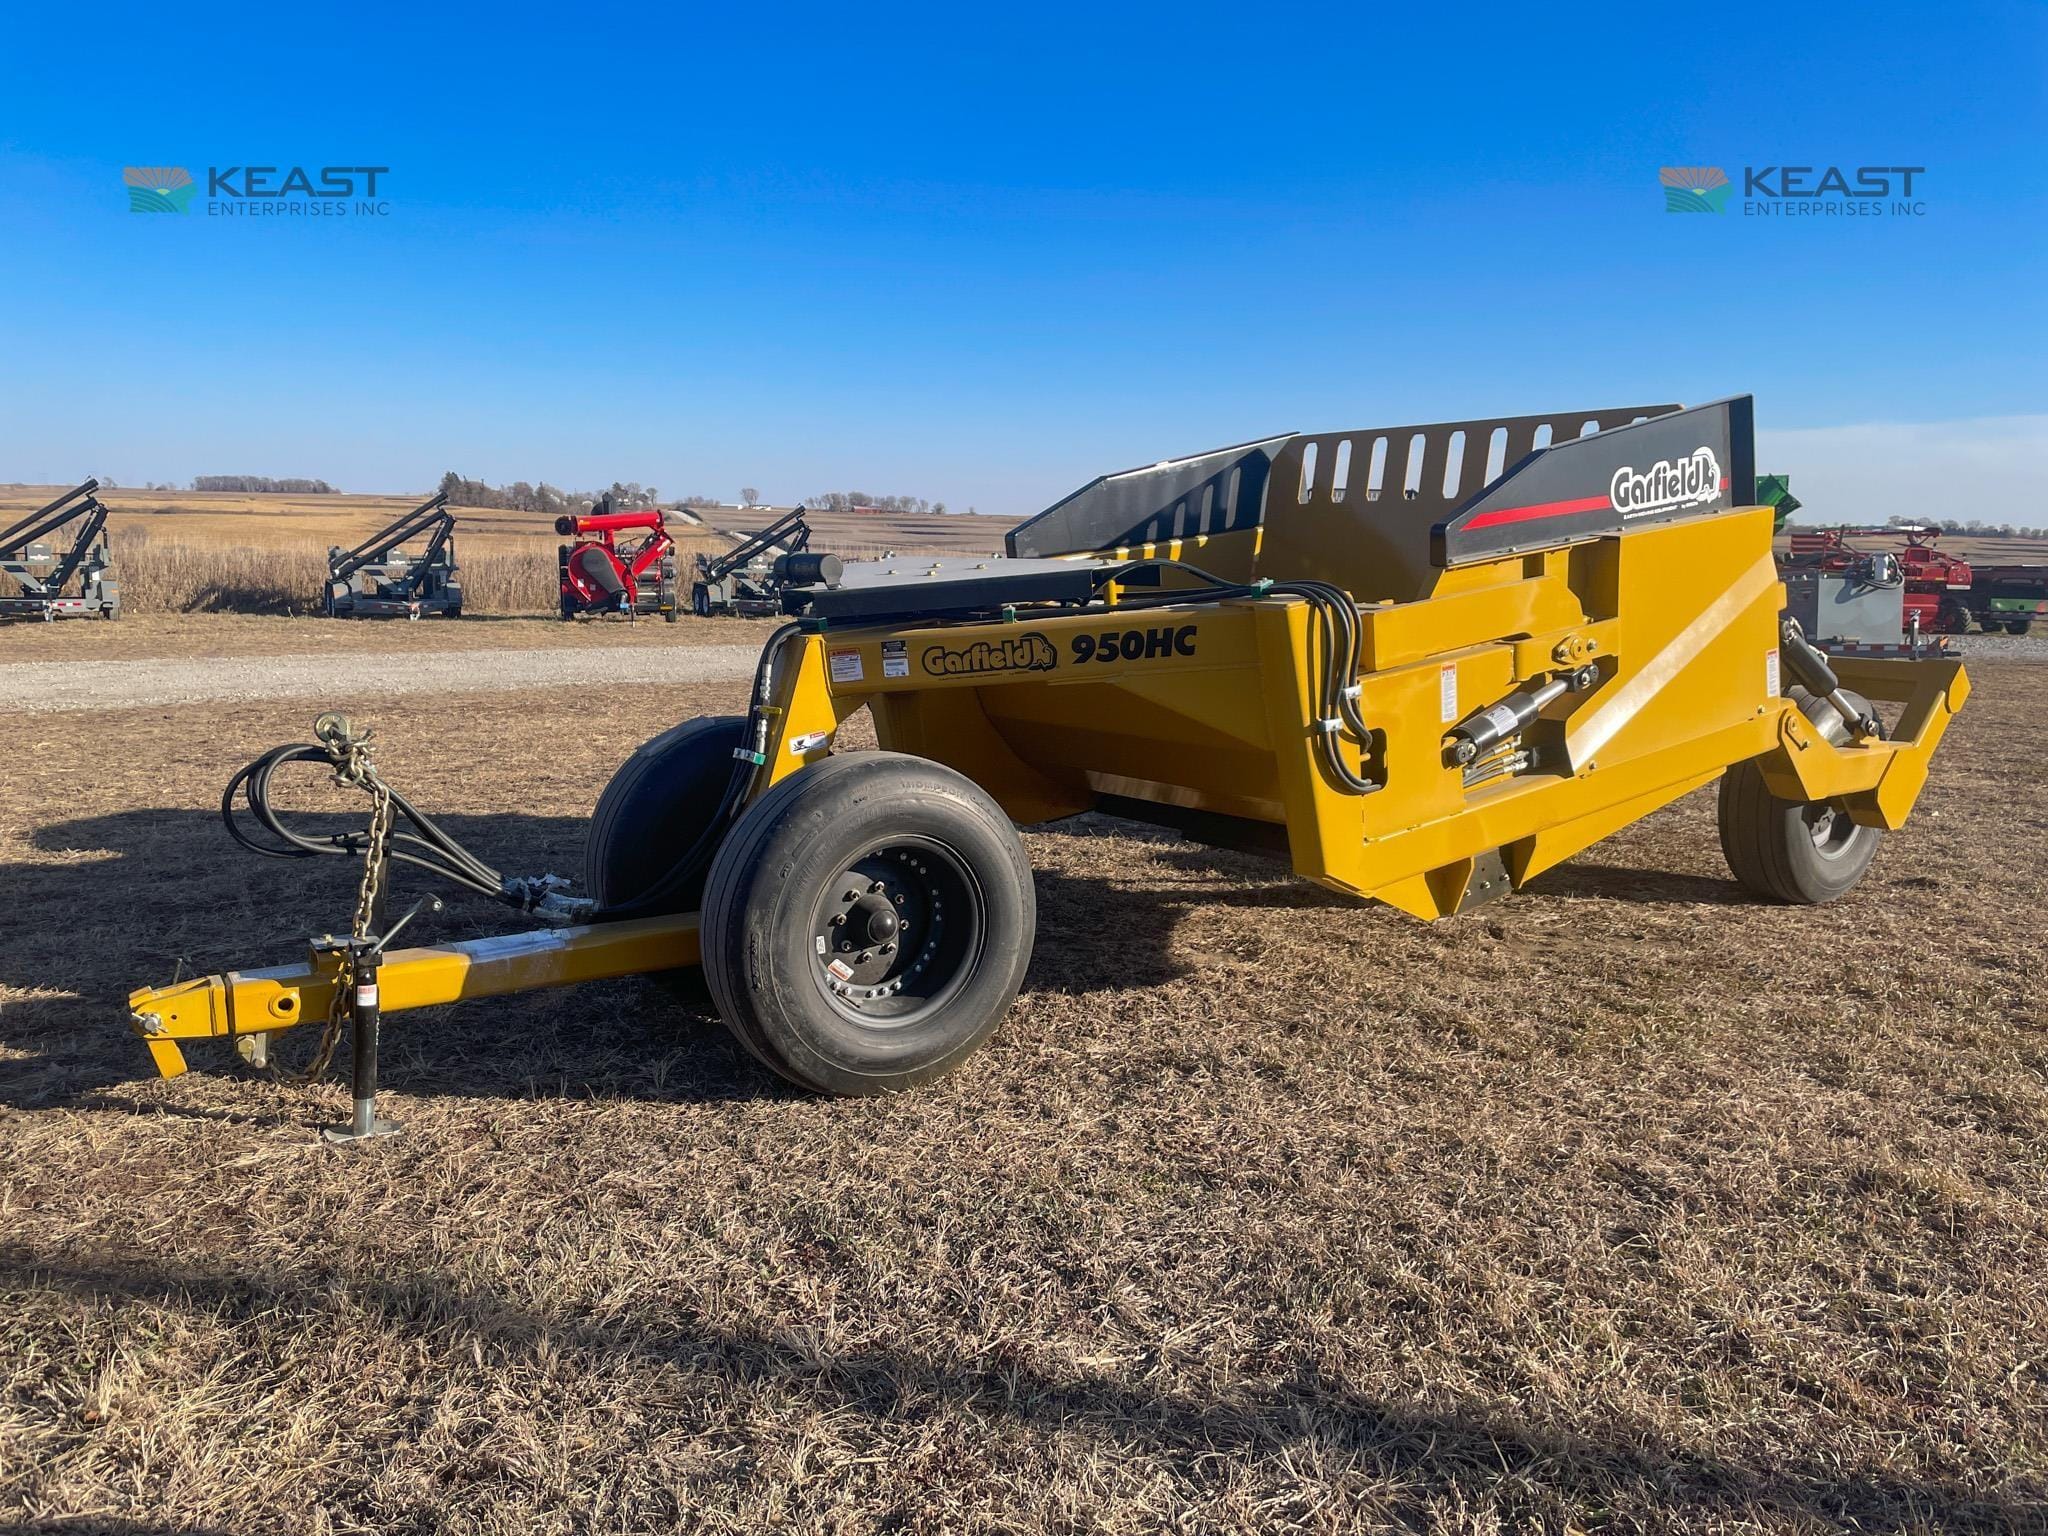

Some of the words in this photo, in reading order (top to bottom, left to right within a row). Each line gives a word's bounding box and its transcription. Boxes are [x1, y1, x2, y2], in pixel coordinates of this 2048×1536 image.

[1611, 457, 1701, 513] Garfield
[921, 639, 1034, 677] Garfield
[1071, 625, 1198, 665] 950HC
